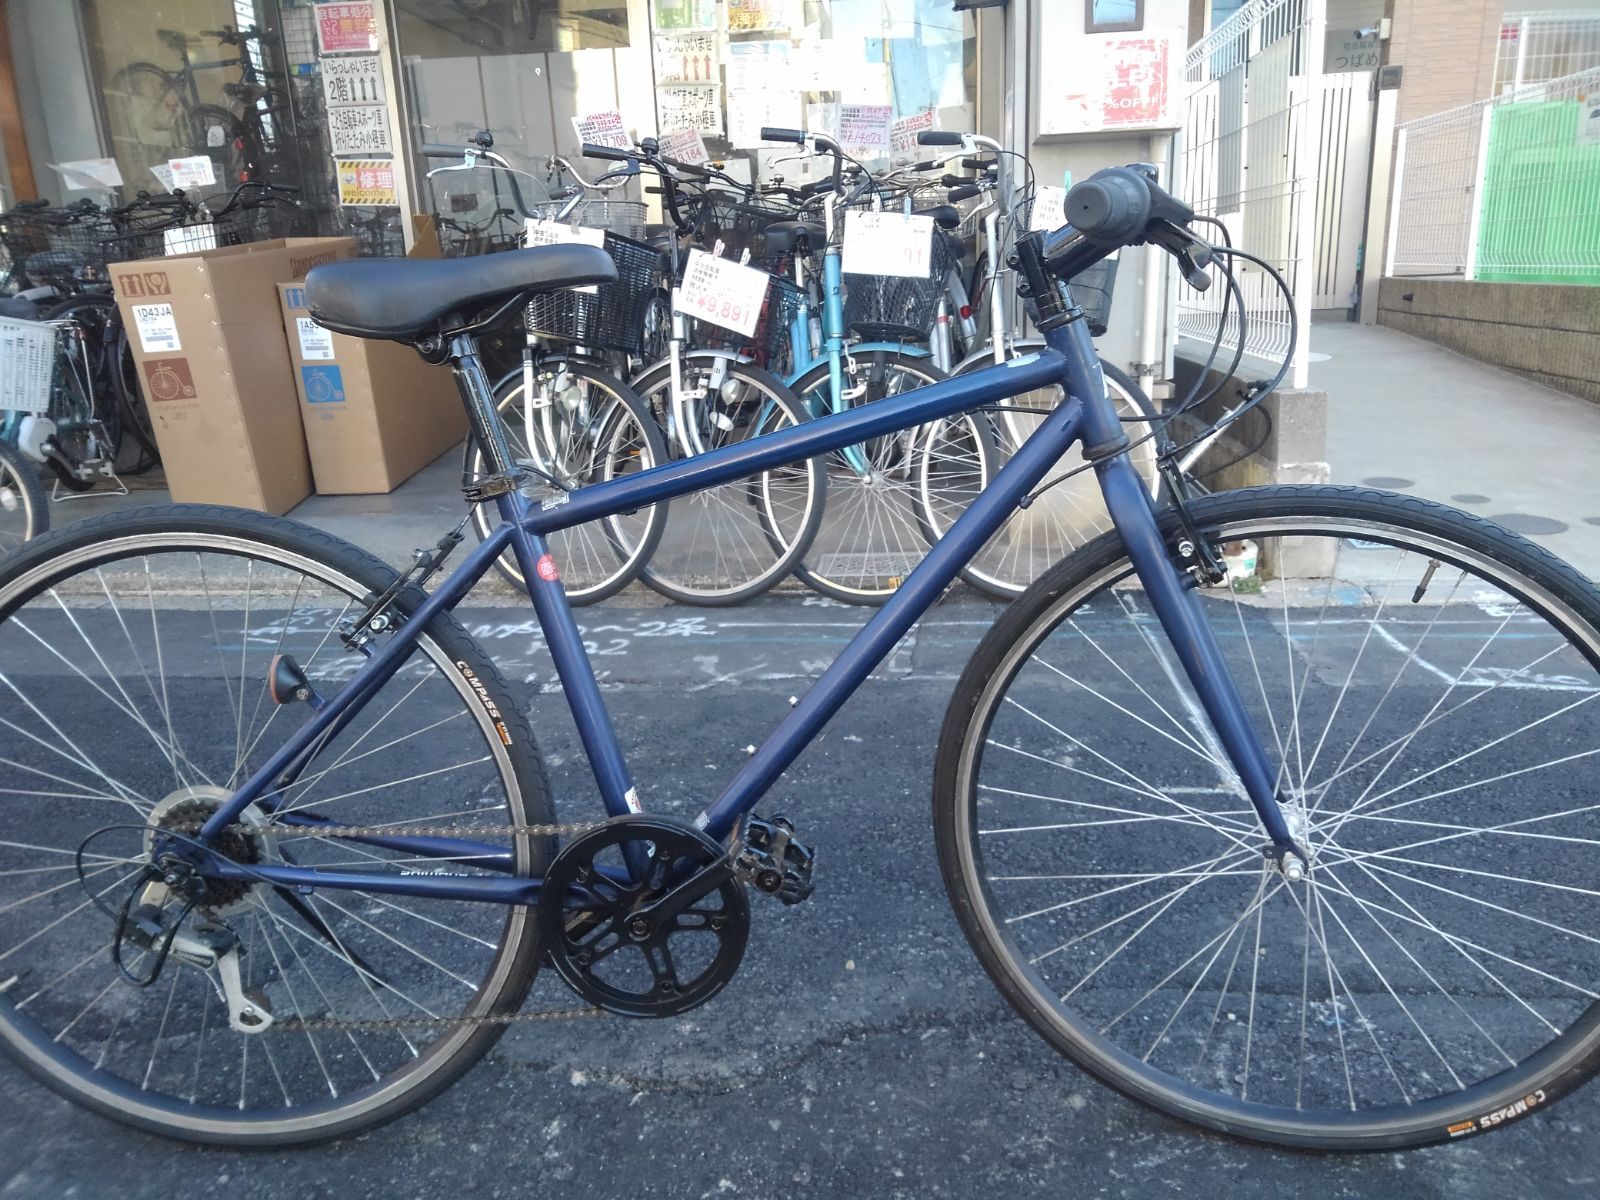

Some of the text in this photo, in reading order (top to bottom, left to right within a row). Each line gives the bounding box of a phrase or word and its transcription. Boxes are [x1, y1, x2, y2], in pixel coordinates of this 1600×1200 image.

[324, 59, 377, 74] いらっしゃいませ
[329, 77, 349, 102] 2階
[360, 171, 393, 189] 修理
[137, 307, 172, 319] 1D43JA
[457, 660, 501, 718] COMPASS
[1480, 1089, 1546, 1128] COMPASS
